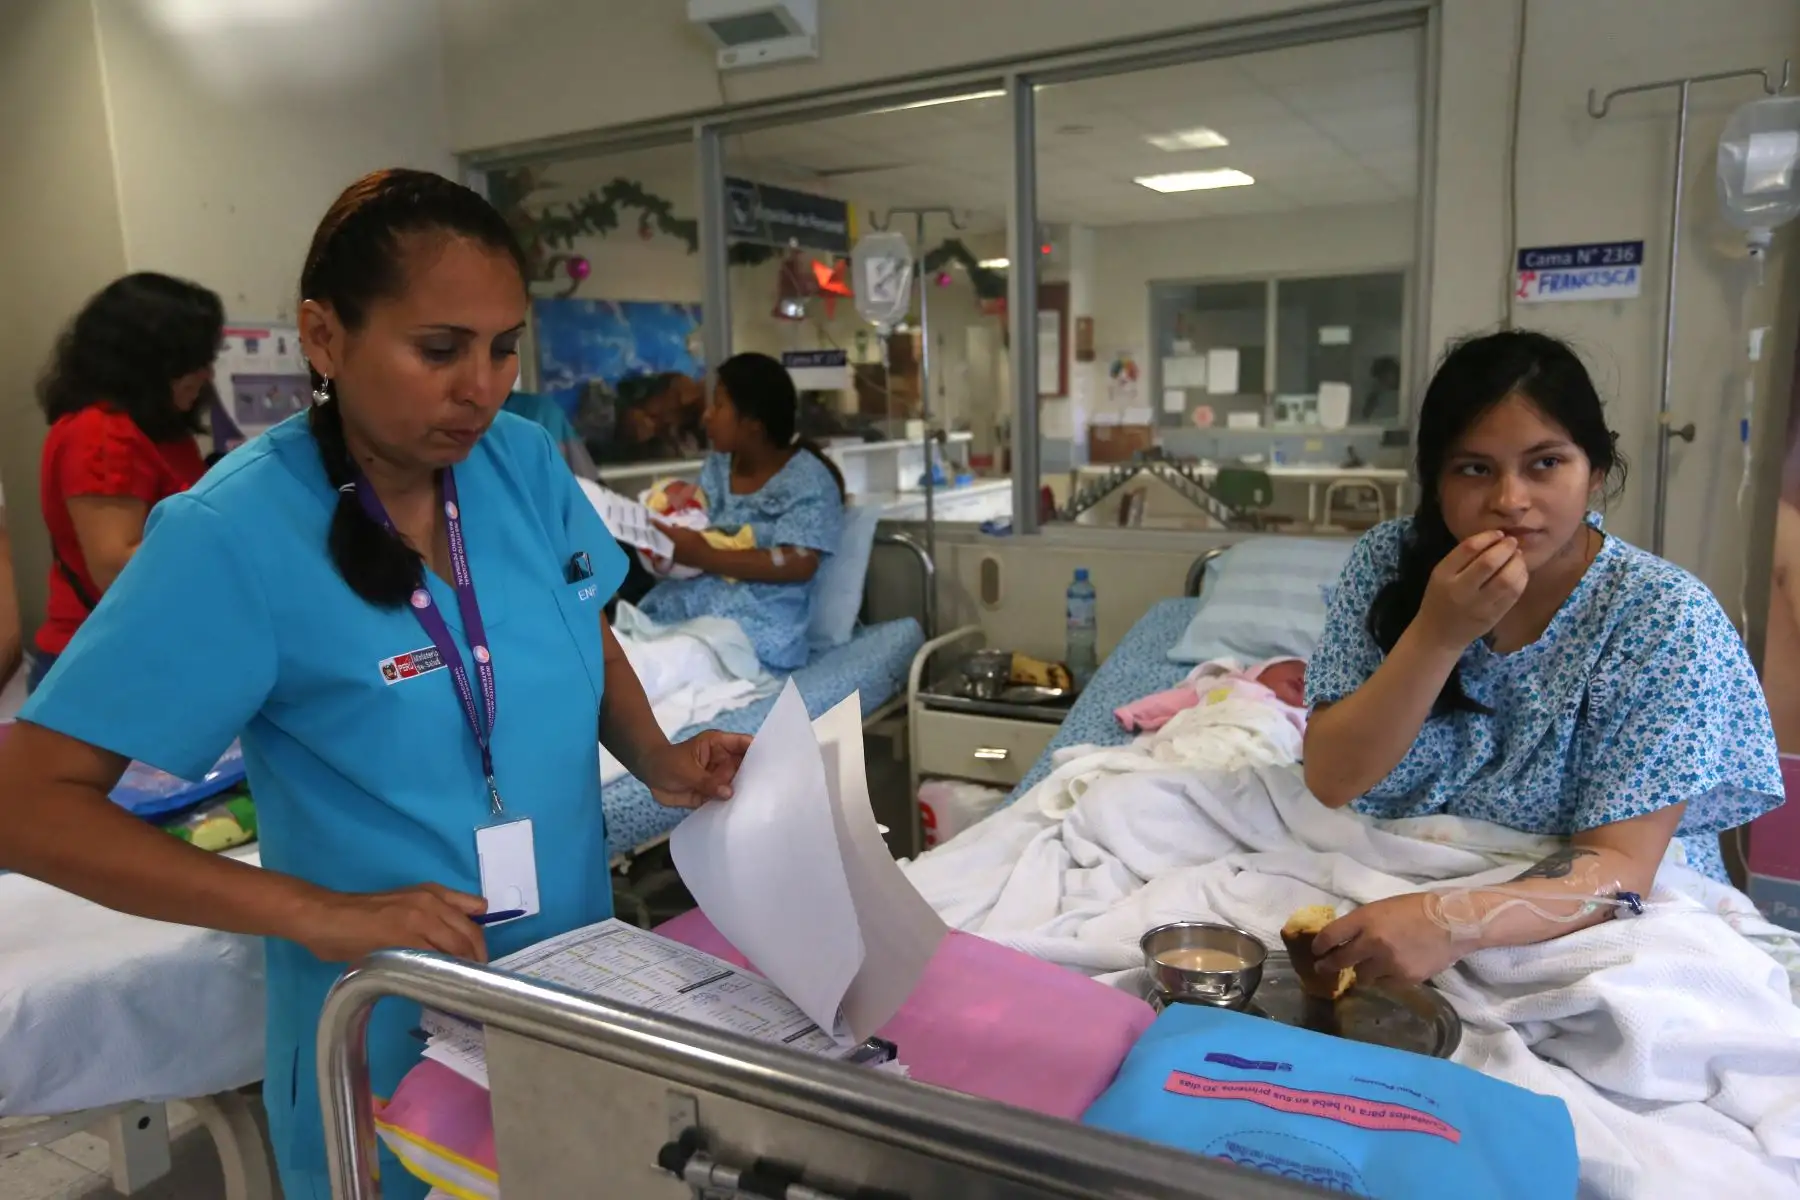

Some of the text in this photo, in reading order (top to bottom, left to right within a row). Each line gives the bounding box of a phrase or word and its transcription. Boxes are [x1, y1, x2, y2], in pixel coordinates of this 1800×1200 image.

[1525, 252, 1572, 267] Cama
[1538, 267, 1637, 294] FRANCISCA
[448, 520, 464, 586] MATERNO PERINATAL
[453, 521, 470, 587] INSTITUTO NACIONAL
[480, 665, 489, 698] MATERNO
[485, 665, 494, 700] INSTITUTO
[1203, 1085, 1217, 1093] 30
[1221, 1085, 1271, 1096] primeros
[1273, 1092, 1292, 1102] sus
[1344, 1103, 1356, 1114] tu
[1359, 1108, 1386, 1118] para
[1389, 1111, 1448, 1131] Cuidados
